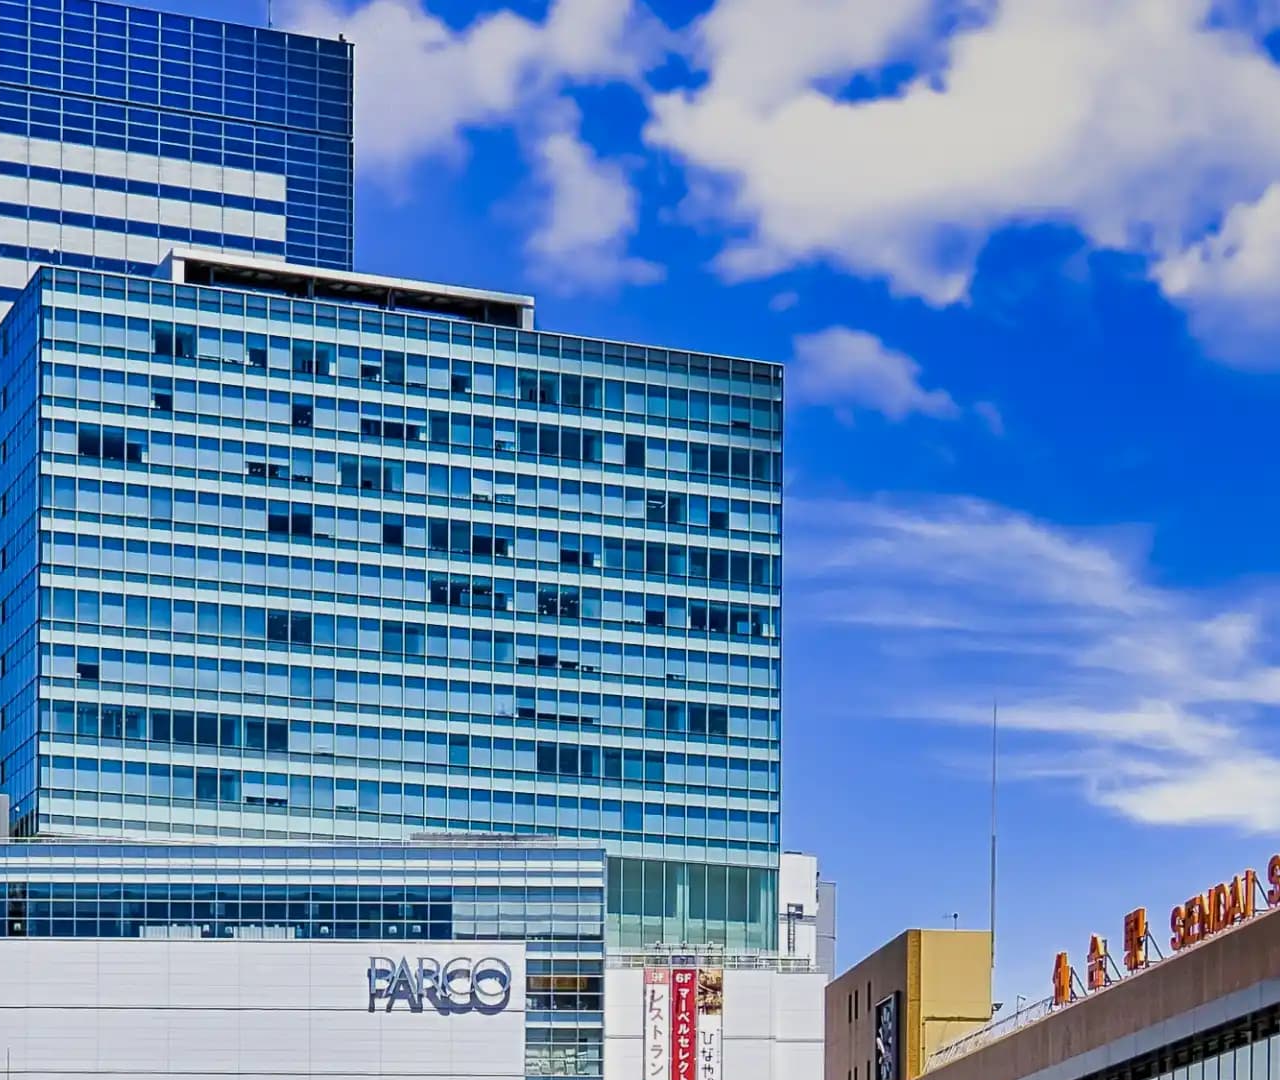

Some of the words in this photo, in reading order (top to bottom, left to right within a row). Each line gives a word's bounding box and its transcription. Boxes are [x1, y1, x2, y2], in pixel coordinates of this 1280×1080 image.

[1052, 906, 1147, 1007] 仙台駅
[1170, 868, 1258, 952] SENDAI
[367, 956, 512, 999] PARCO
[675, 973, 692, 984] 6F
